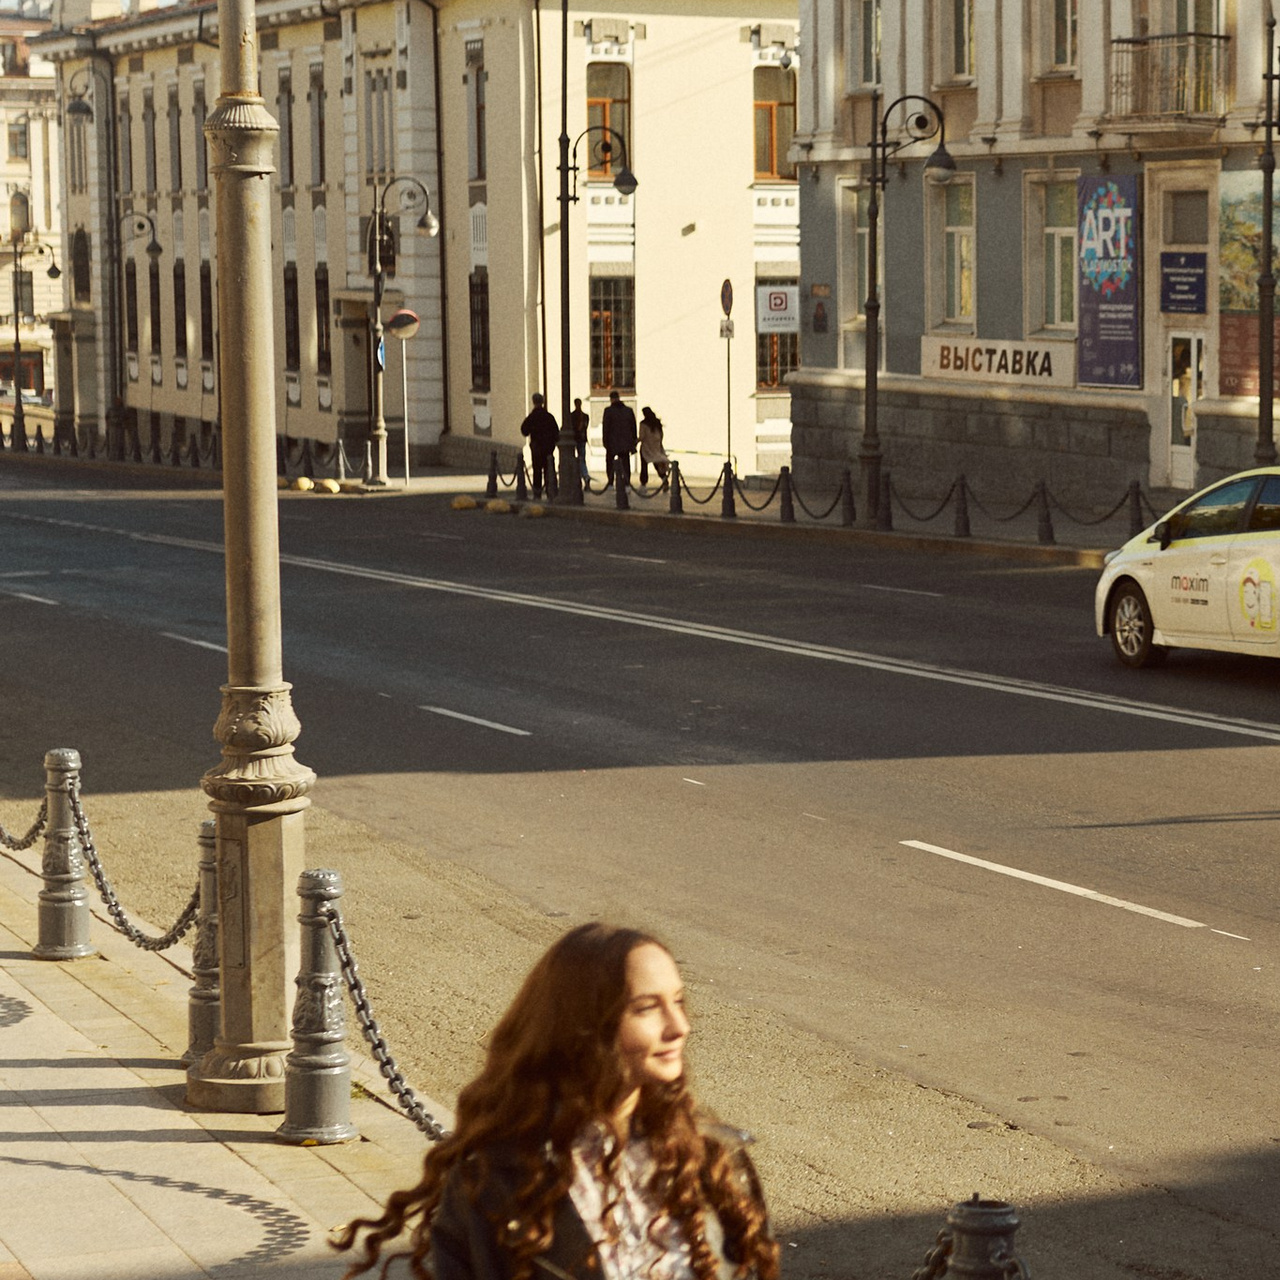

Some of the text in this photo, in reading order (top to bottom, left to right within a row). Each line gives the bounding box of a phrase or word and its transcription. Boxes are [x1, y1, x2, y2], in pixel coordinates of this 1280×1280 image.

[1080, 207, 1133, 259] ART
[939, 345, 1053, 377] ВЫСТАВКА
[1171, 573, 1209, 592] maxim
